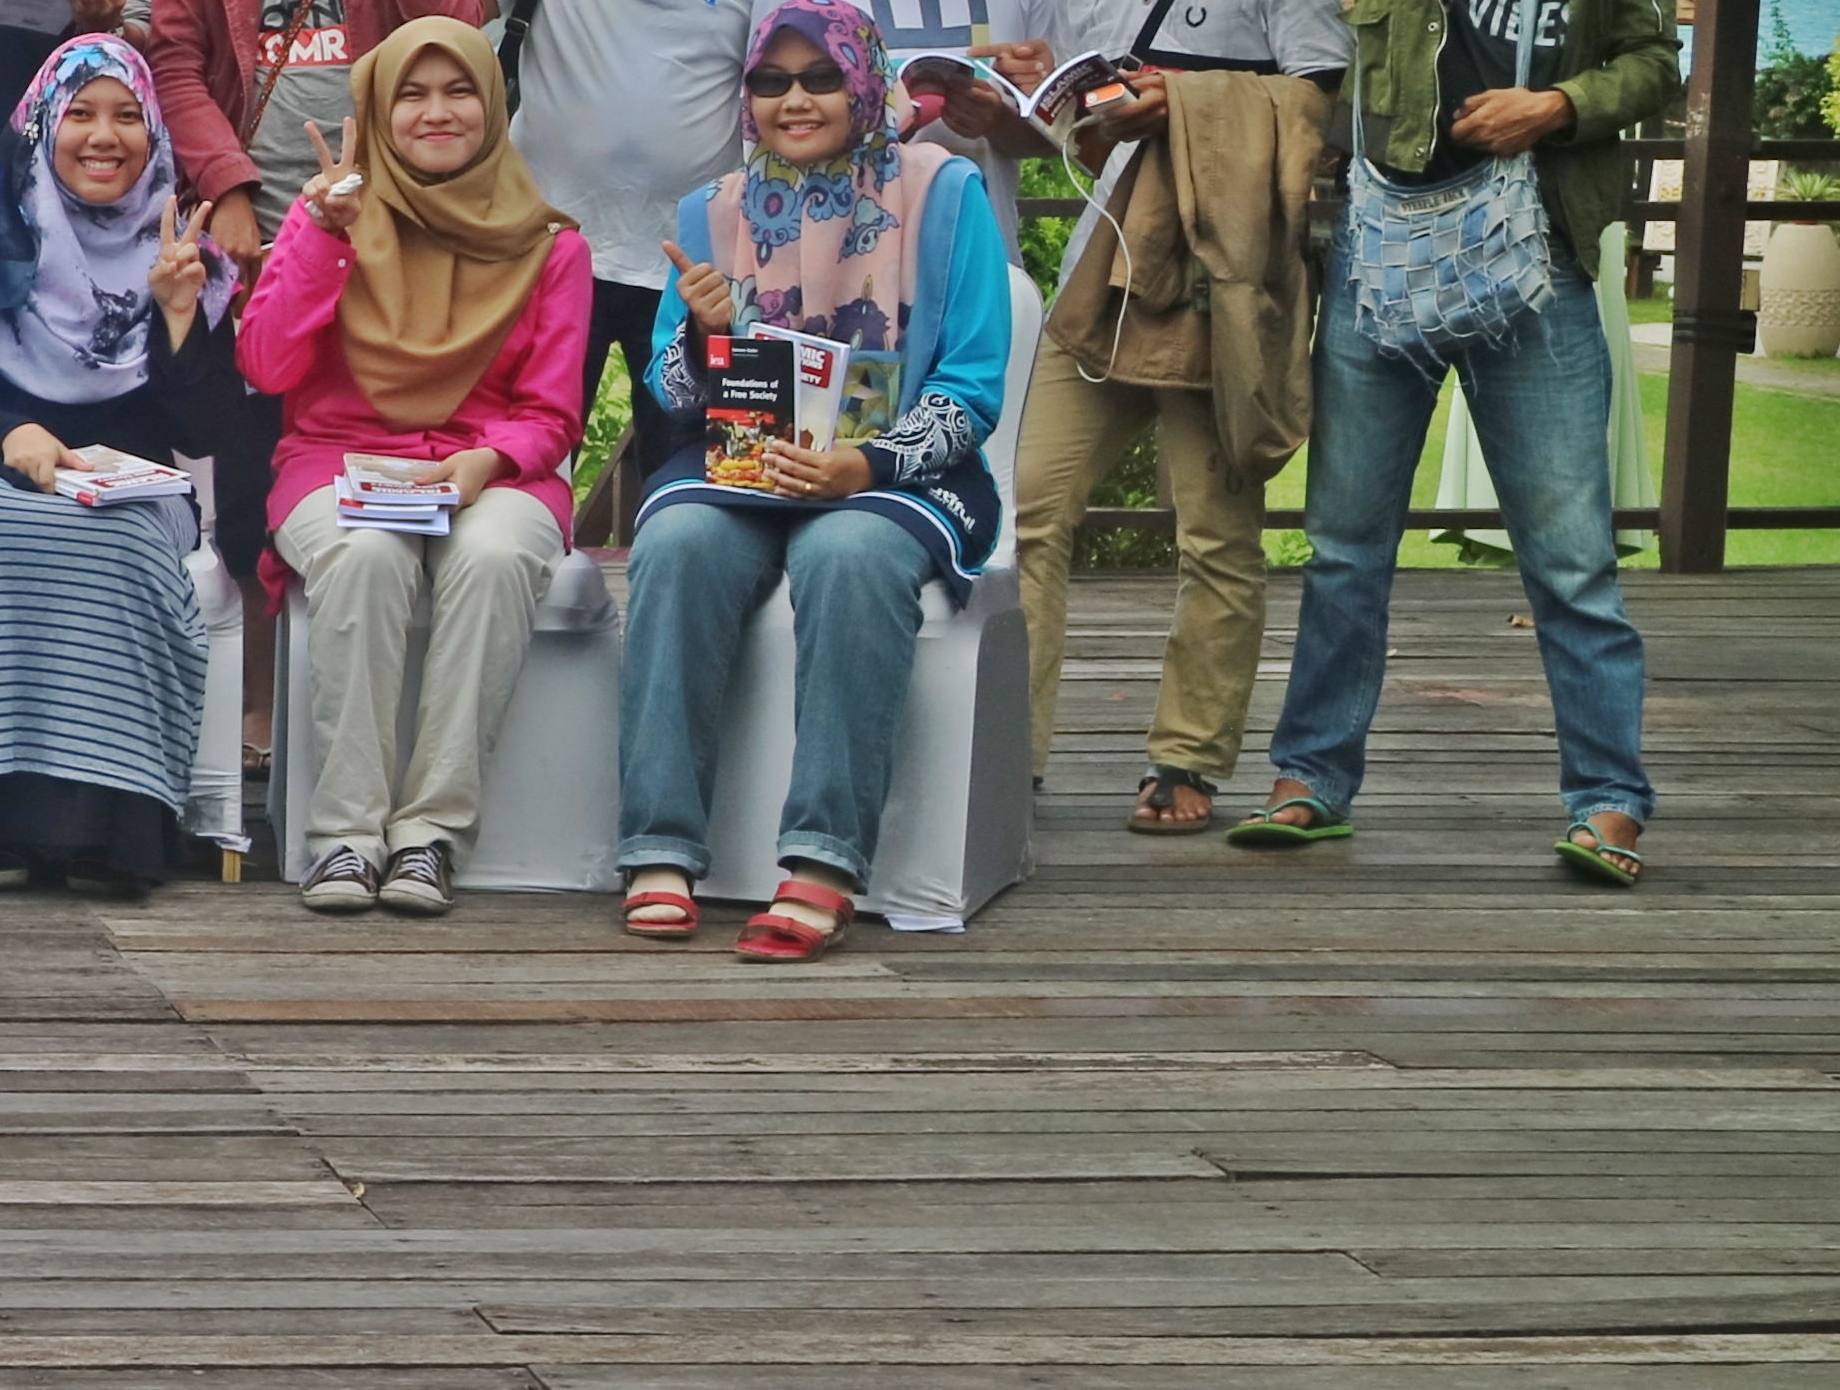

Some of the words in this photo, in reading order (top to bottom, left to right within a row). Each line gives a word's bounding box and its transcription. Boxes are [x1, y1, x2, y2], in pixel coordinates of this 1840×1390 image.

[709, 354, 725, 366] iea
[722, 377, 768, 389] Foundations
[769, 379, 779, 389] of
[722, 391, 729, 399] a
[730, 388, 747, 400] Free
[749, 391, 778, 402] Society
